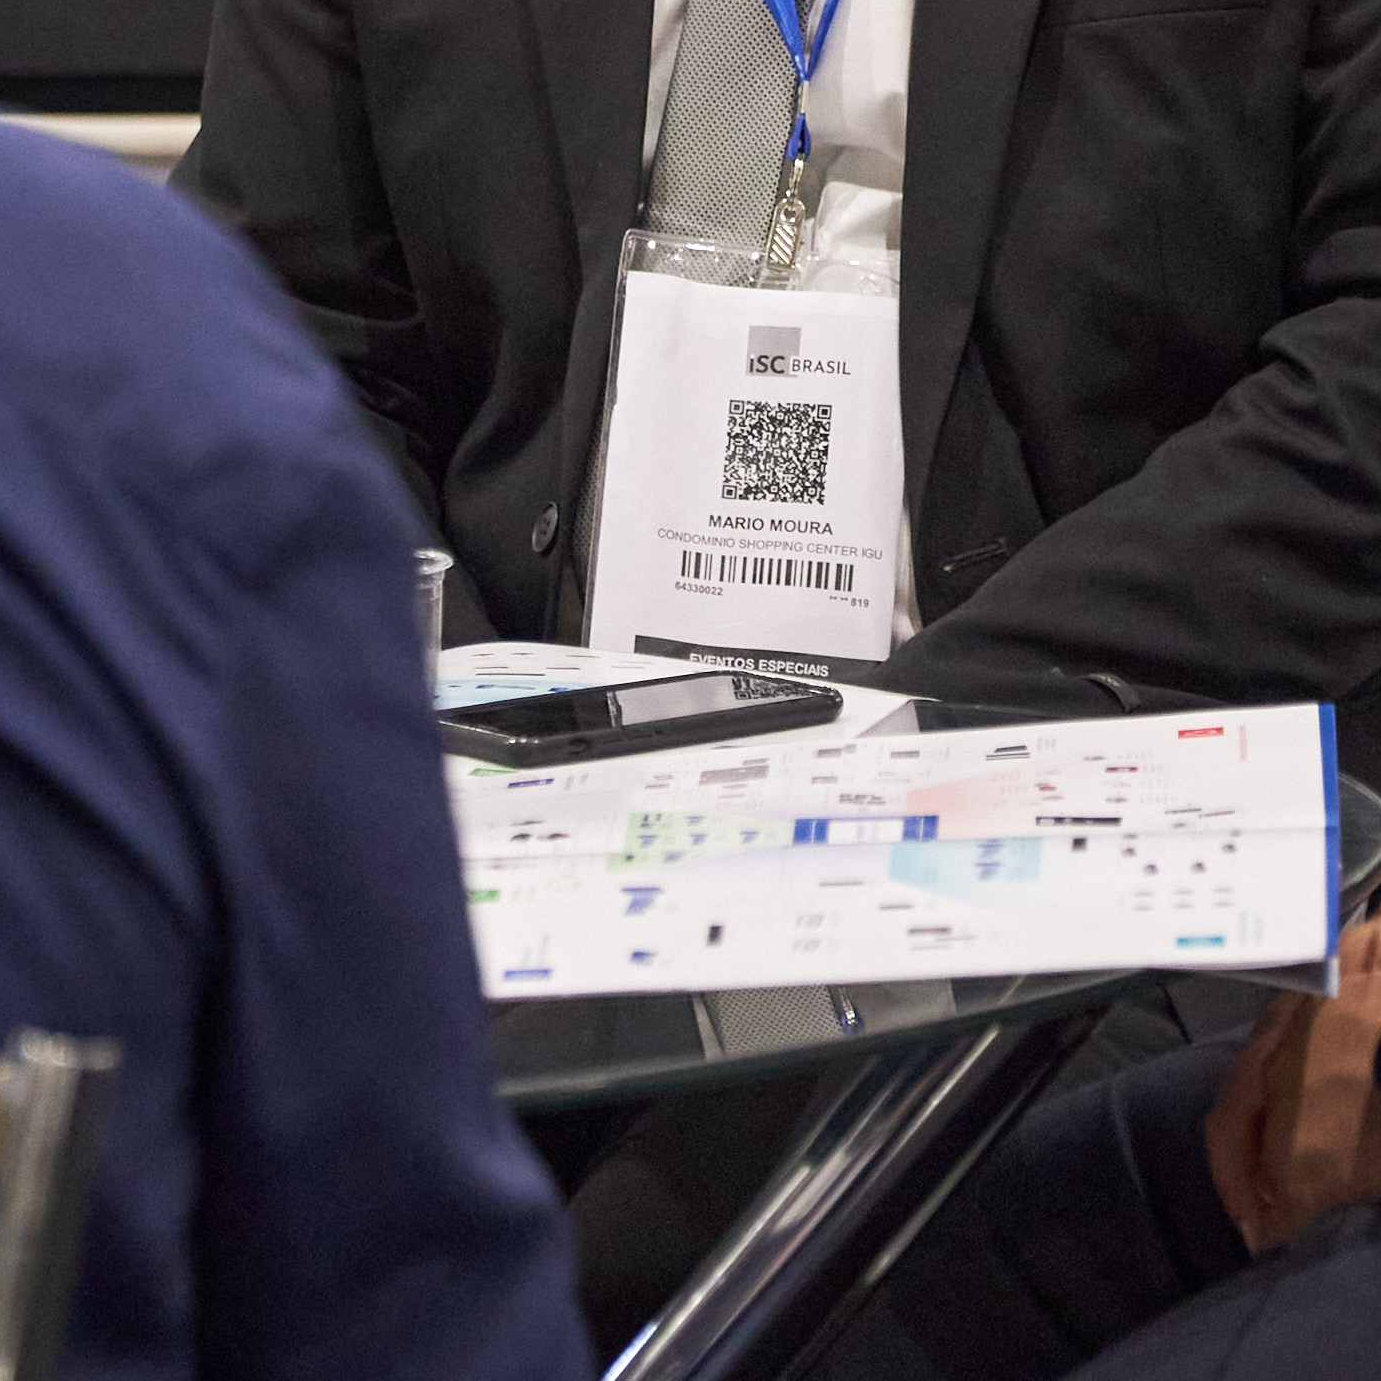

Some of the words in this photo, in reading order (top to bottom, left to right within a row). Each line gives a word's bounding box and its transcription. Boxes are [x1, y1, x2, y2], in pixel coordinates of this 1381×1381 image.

[792, 359, 851, 375] BRASIL
[708, 515, 764, 531] MARIO
[770, 519, 833, 535] MOURA
[657, 528, 735, 548] CONDOMINIO
[739, 539, 803, 552] SHOPPING
[807, 542, 858, 558] CENTER
[862, 548, 883, 560] IGU
[675, 581, 723, 596] 64330022
[689, 652, 755, 670] EVENTOS
[758, 659, 829, 677] ESPECIAIS
